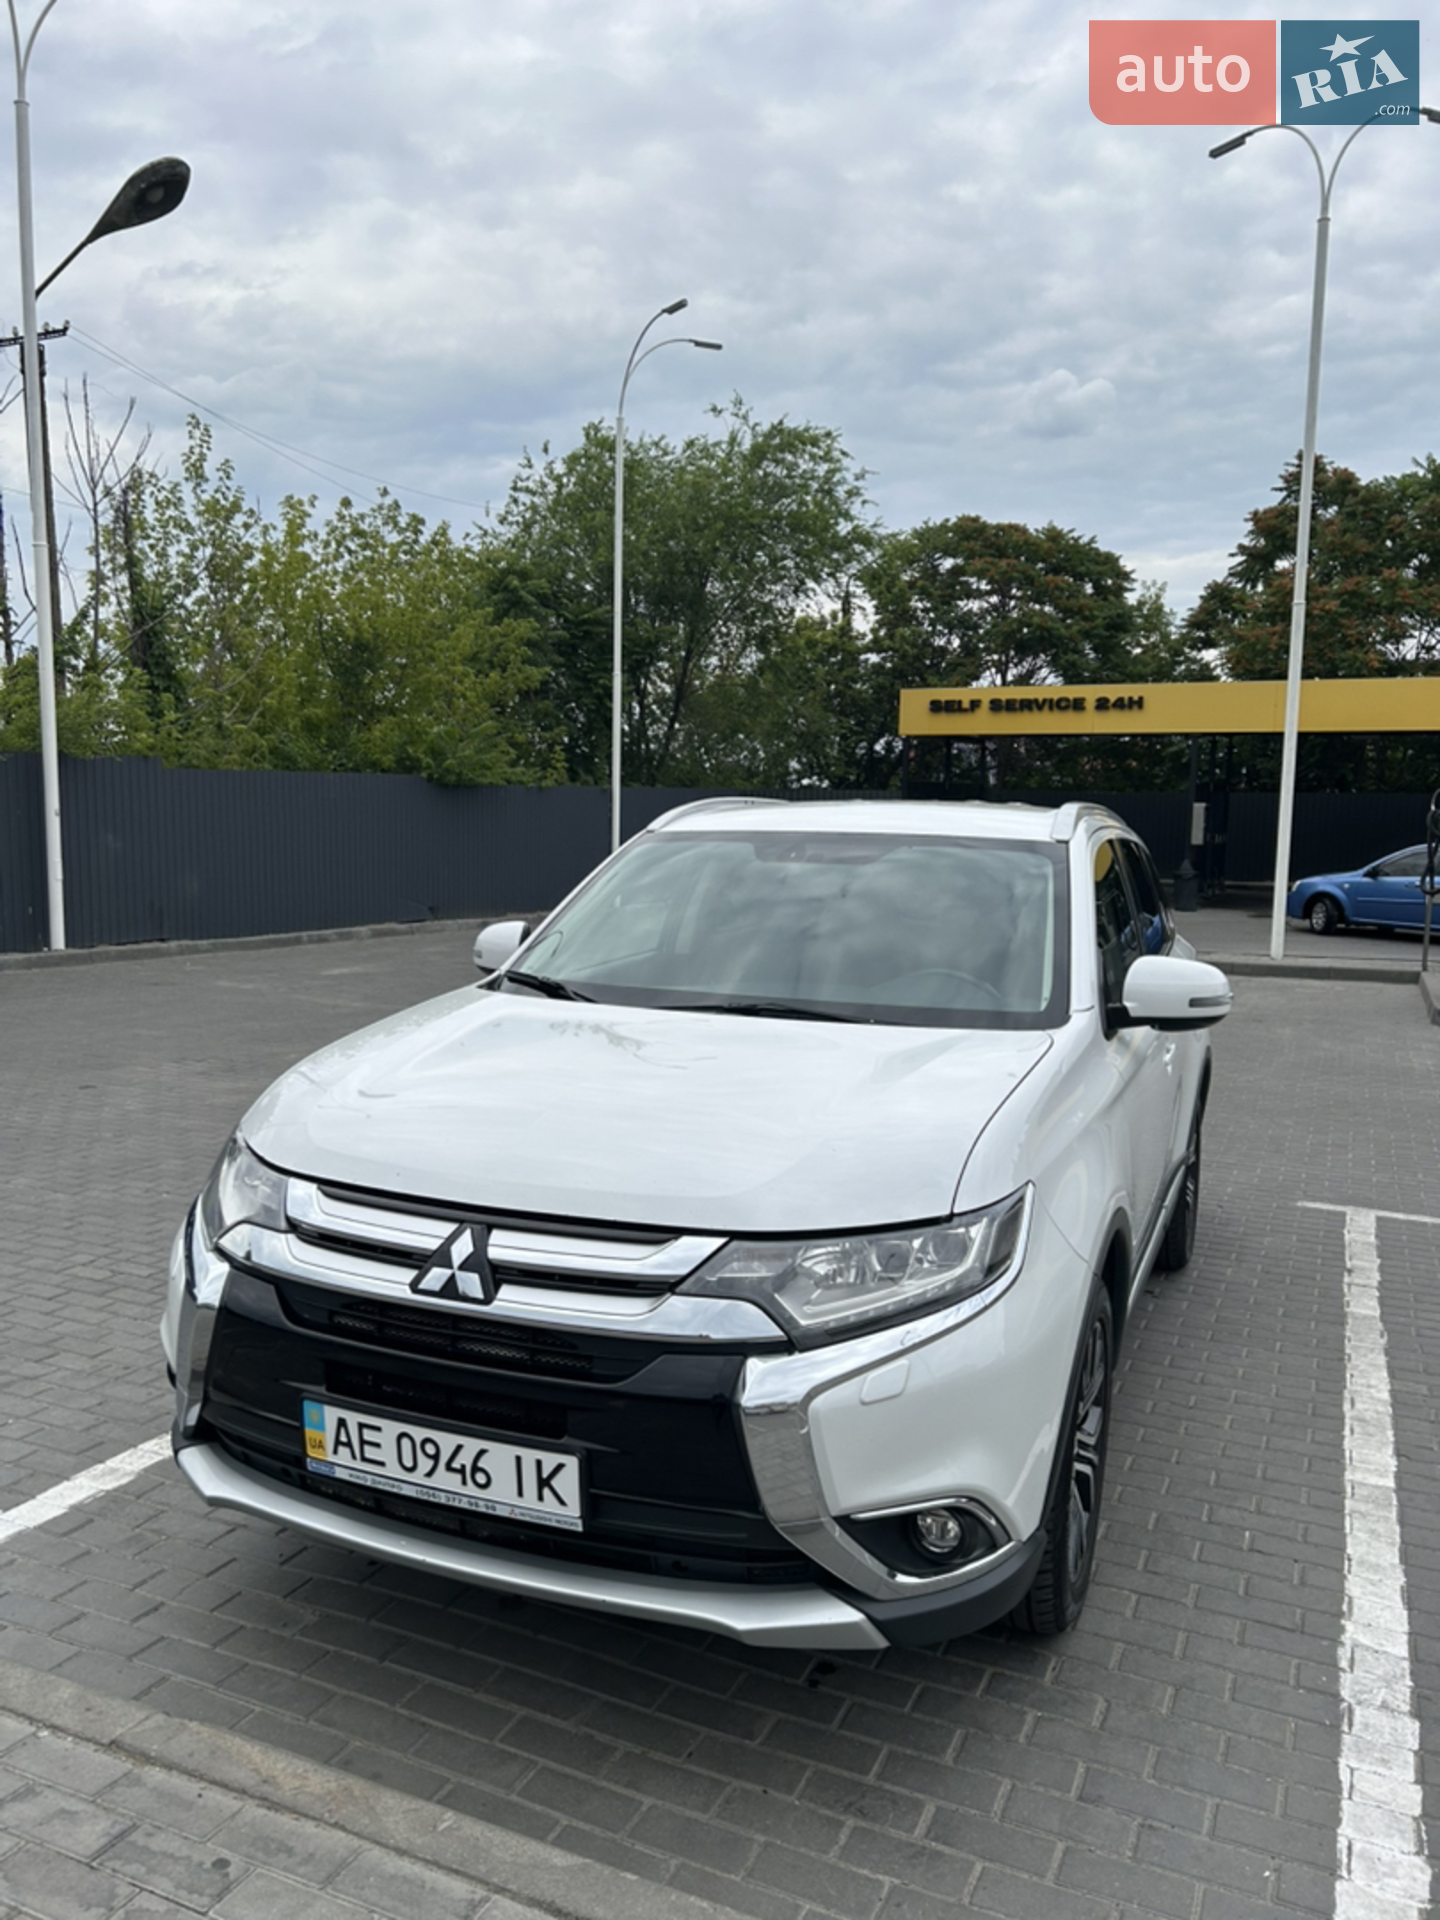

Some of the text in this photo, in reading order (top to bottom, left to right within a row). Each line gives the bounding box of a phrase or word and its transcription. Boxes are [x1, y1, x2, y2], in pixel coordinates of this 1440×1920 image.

[929, 696, 1144, 713] SELF SERVICE 24H
[308, 1436, 326, 1451] UA
[332, 1416, 568, 1507] AE 0946 IK
